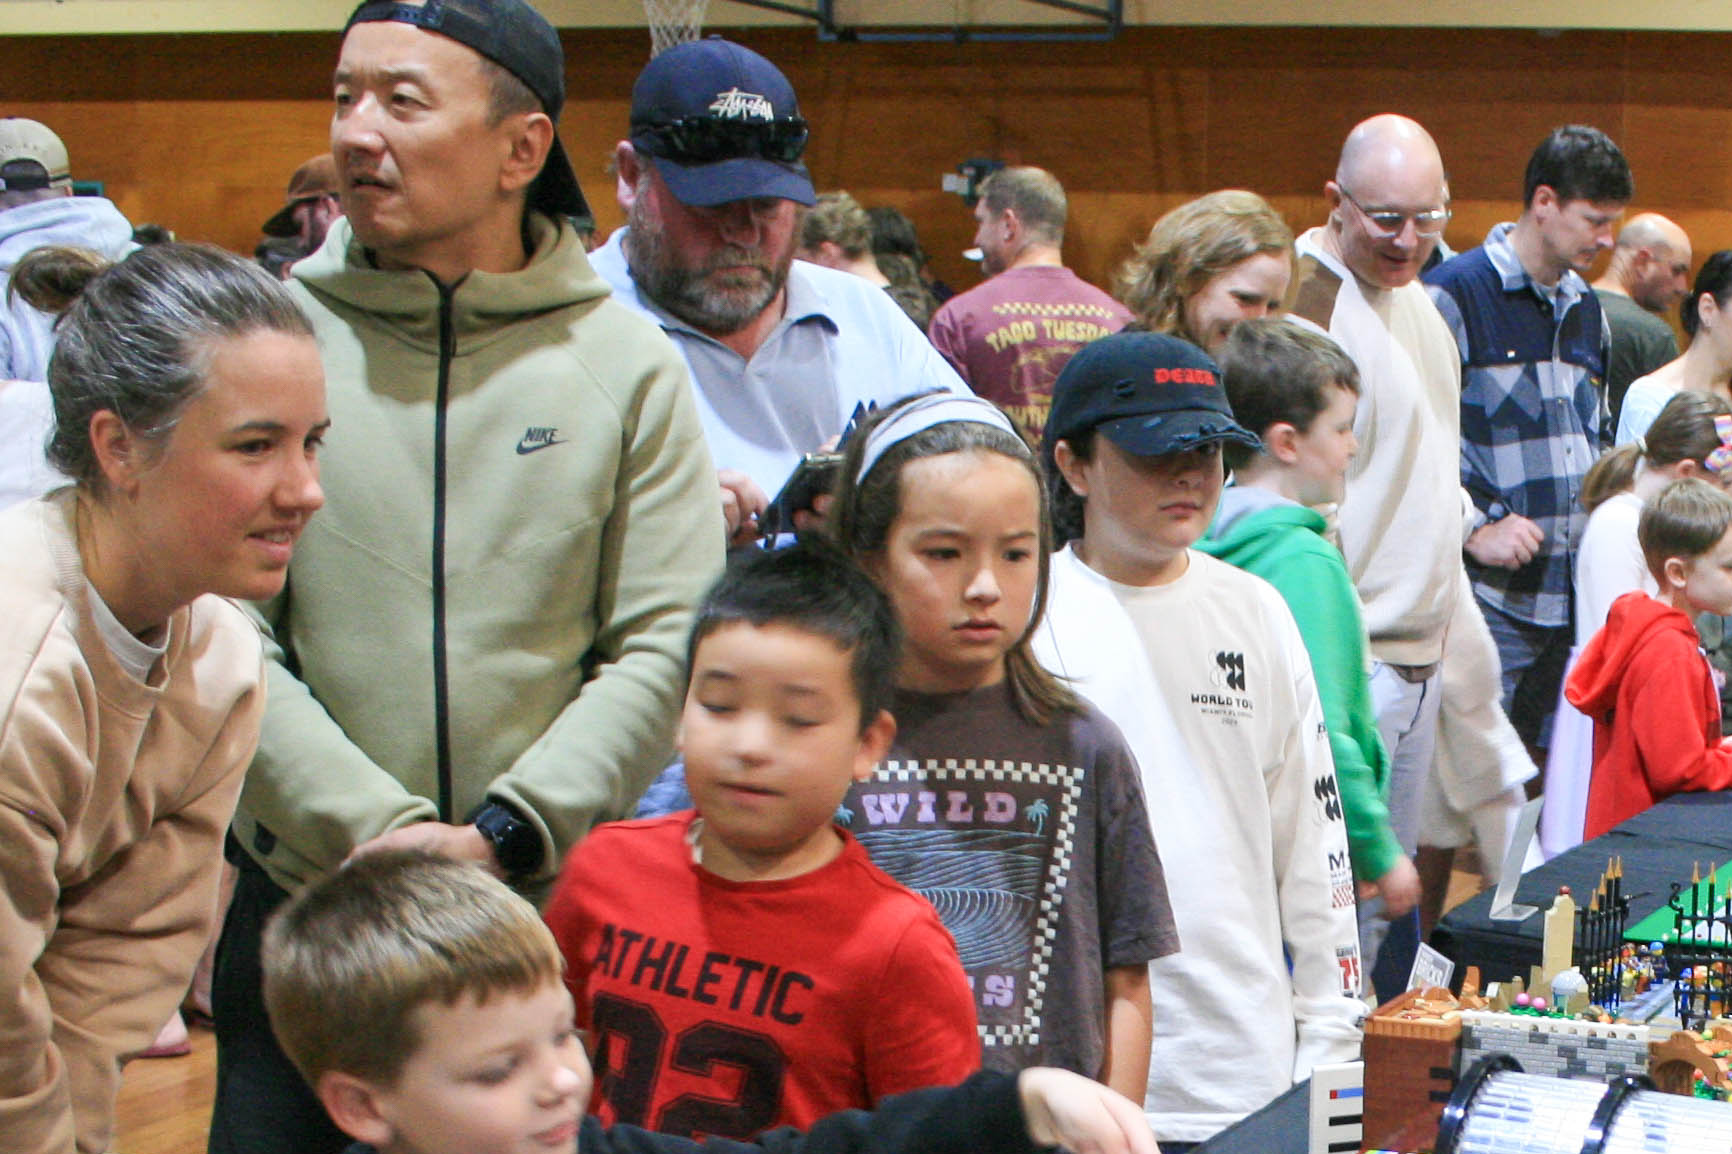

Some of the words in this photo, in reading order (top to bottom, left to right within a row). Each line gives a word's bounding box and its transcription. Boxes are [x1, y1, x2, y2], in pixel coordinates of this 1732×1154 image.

[985, 320, 1037, 353] TACO
[1041, 318, 1112, 343] TUESD
[525, 427, 559, 444] NIKE
[1191, 694, 1233, 706] WORLD
[861, 790, 1018, 826] WILD
[594, 923, 815, 1025] ATHLETIC
